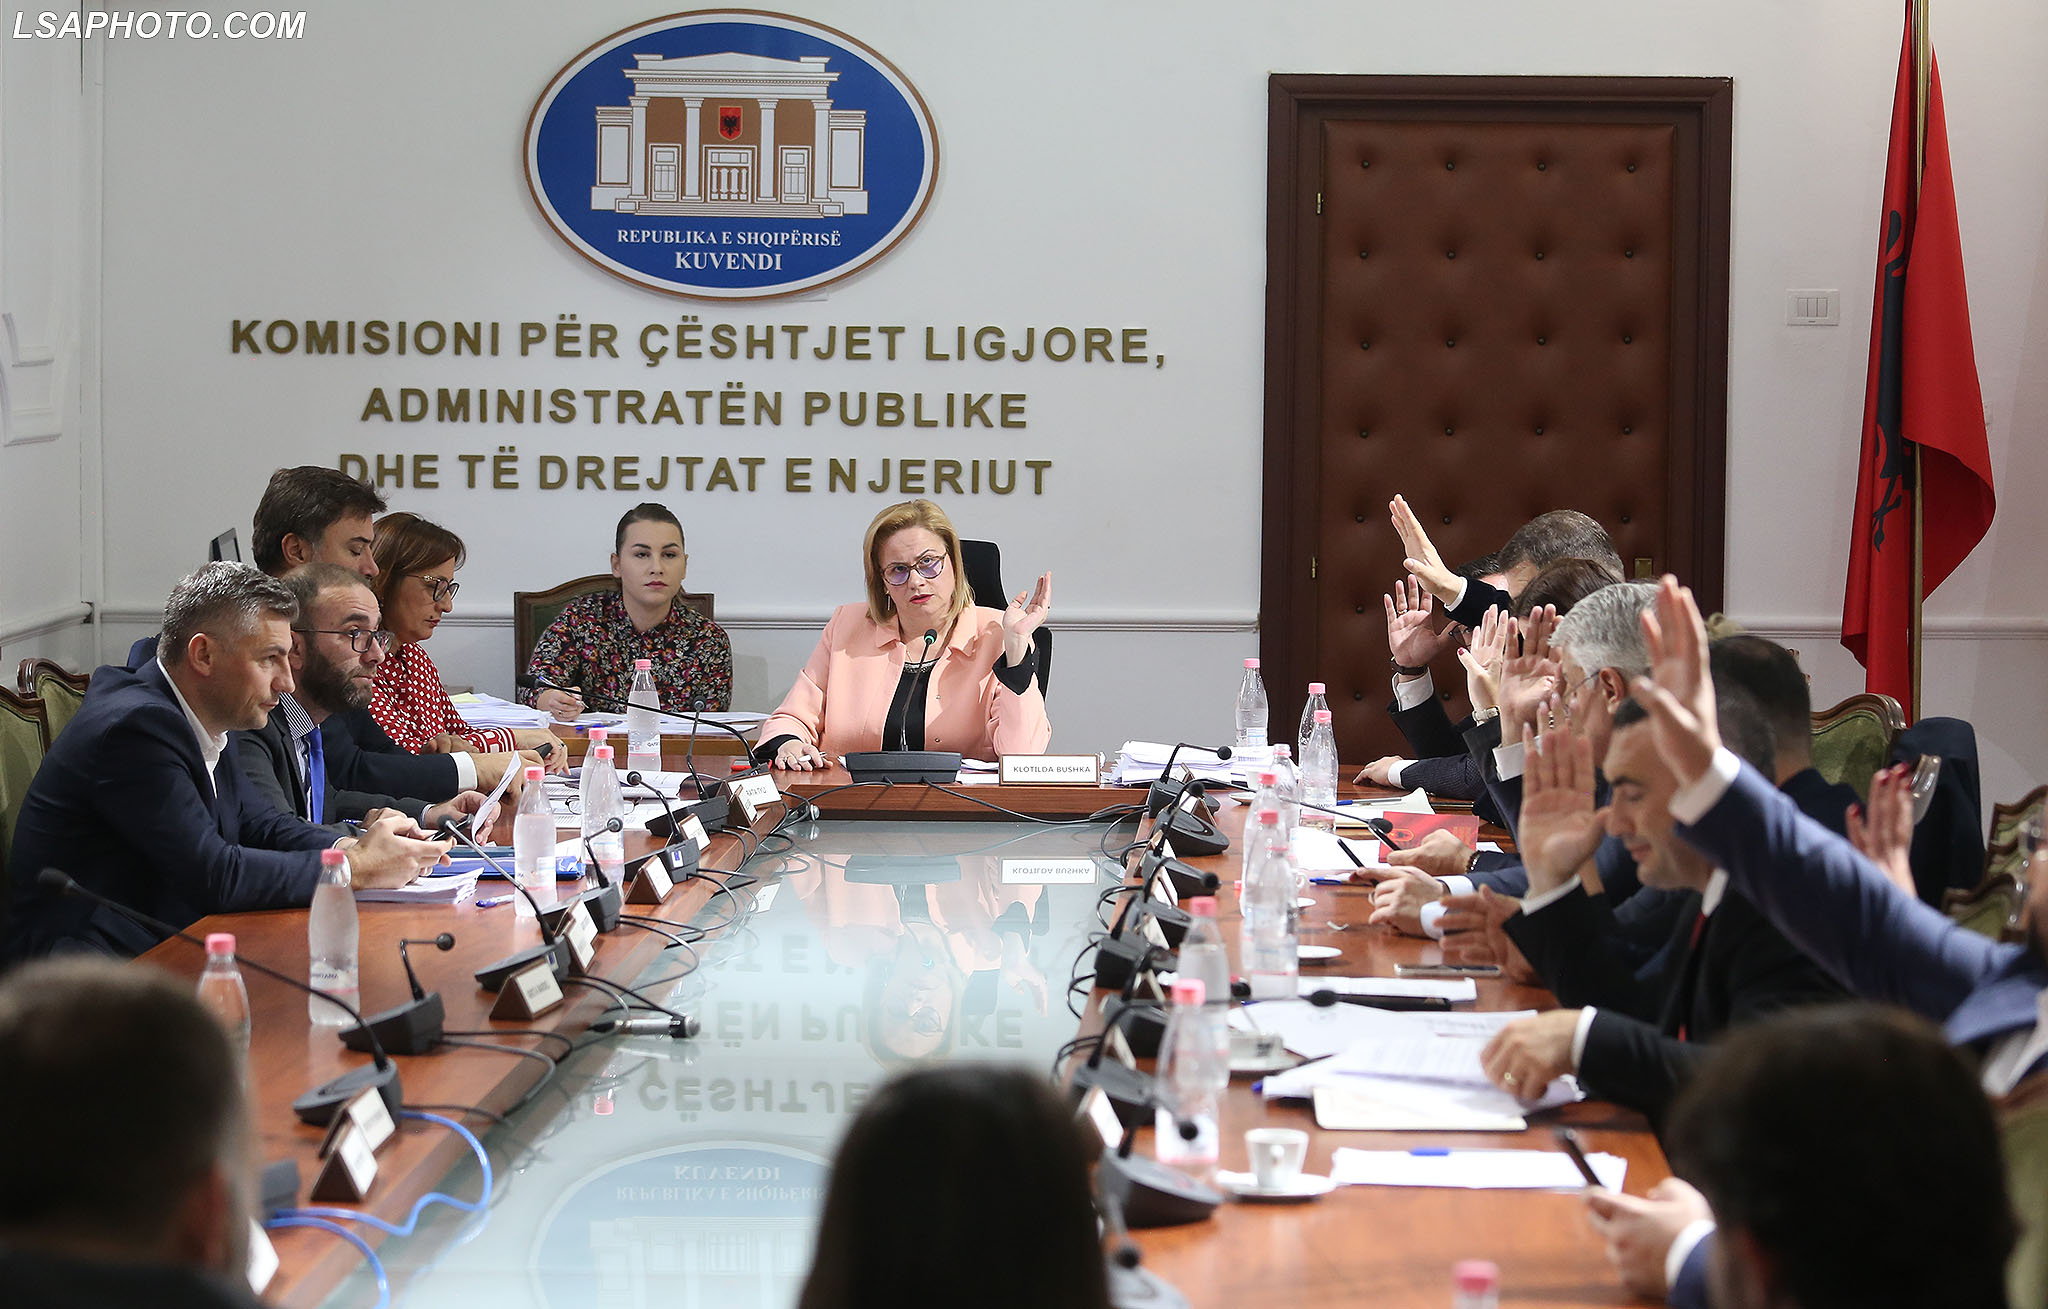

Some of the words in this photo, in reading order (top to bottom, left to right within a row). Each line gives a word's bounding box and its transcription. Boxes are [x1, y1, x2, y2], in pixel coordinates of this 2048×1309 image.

[617, 229, 717, 244] REPUBLIKA
[722, 231, 732, 245] E
[737, 230, 841, 248] SHQIPËRISË
[675, 251, 783, 271] KUVENDI
[231, 319, 501, 357] KOMISIONI
[520, 314, 620, 359] PËR
[639, 316, 906, 367] ÇËSHTJET
[925, 326, 1167, 369] LIGJORE,
[361, 382, 784, 426] ADMINISTRATËN
[804, 391, 1029, 429] PUBLIKE
[339, 453, 440, 489] DHE
[458, 446, 519, 490] TË
[539, 456, 767, 493] DREJTAT
[786, 458, 814, 494] E
[829, 459, 1055, 496] NJERIUT
[1013, 765, 1054, 774] KLOTILDA
[1056, 765, 1091, 774] BUSHKA
